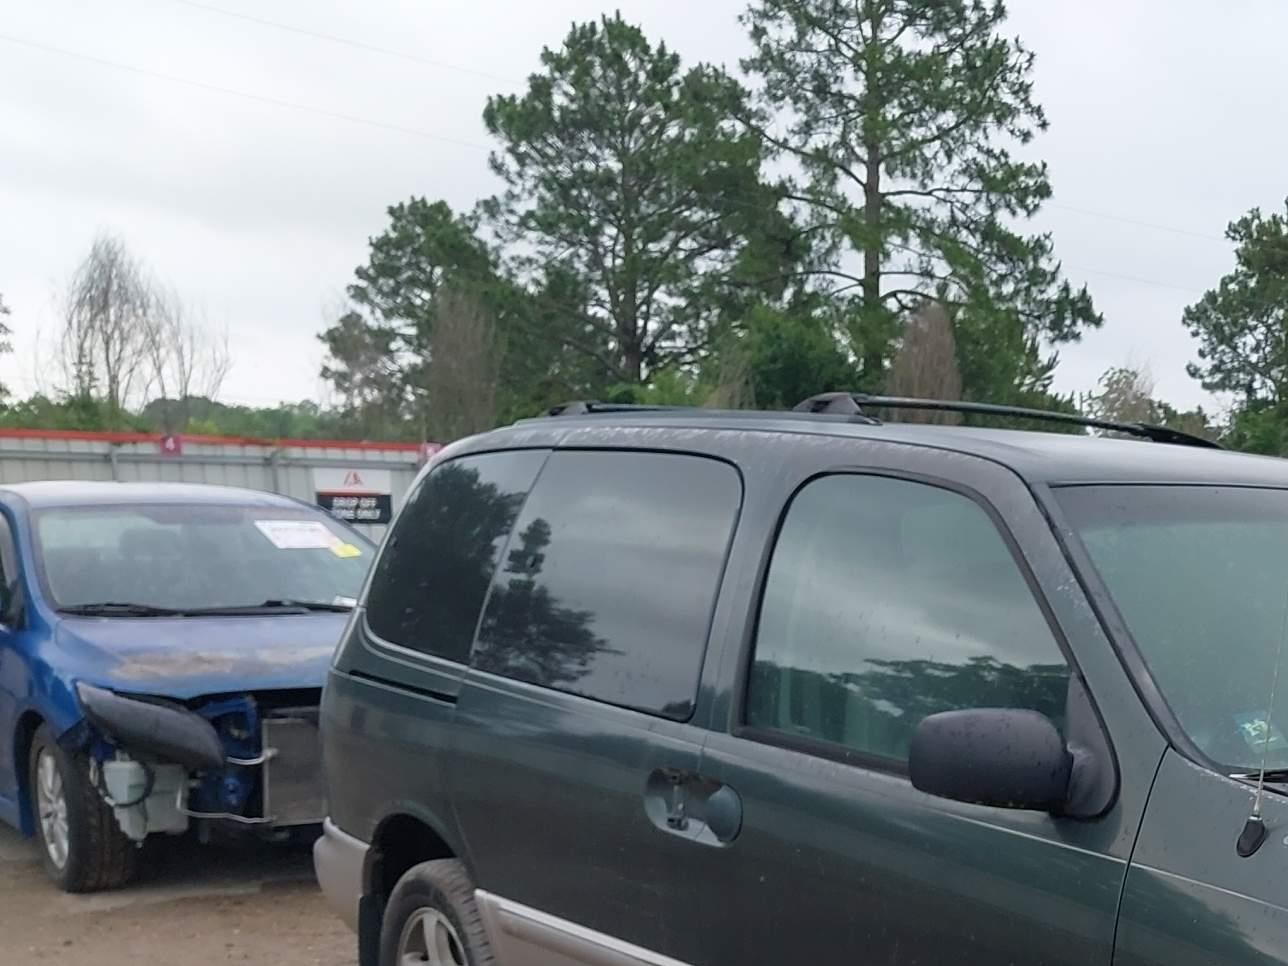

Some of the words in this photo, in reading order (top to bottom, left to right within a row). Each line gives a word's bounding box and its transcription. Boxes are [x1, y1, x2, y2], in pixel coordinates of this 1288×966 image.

[333, 496, 359, 509] DROP
[360, 497, 377, 509] OFF
[357, 508, 381, 520] ONLY
